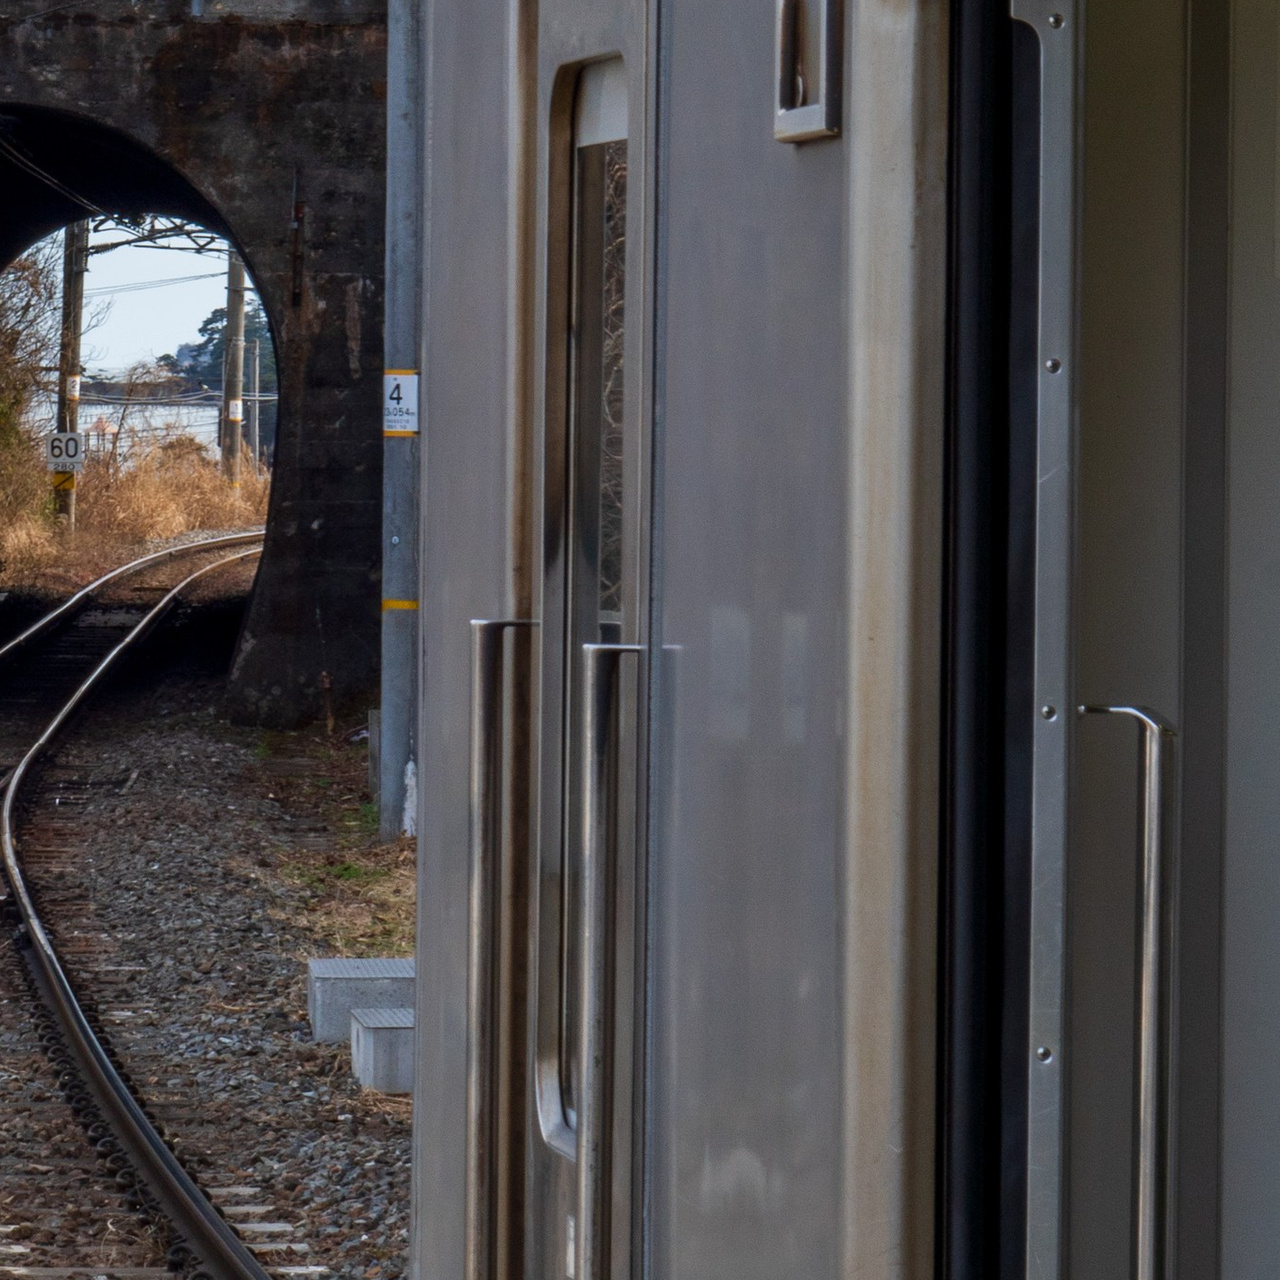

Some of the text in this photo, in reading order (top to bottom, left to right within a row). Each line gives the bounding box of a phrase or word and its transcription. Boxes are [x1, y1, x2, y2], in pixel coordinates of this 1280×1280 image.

[389, 383, 403, 405] 4
[50, 437, 79, 459] 60
[52, 463, 75, 471] 280
